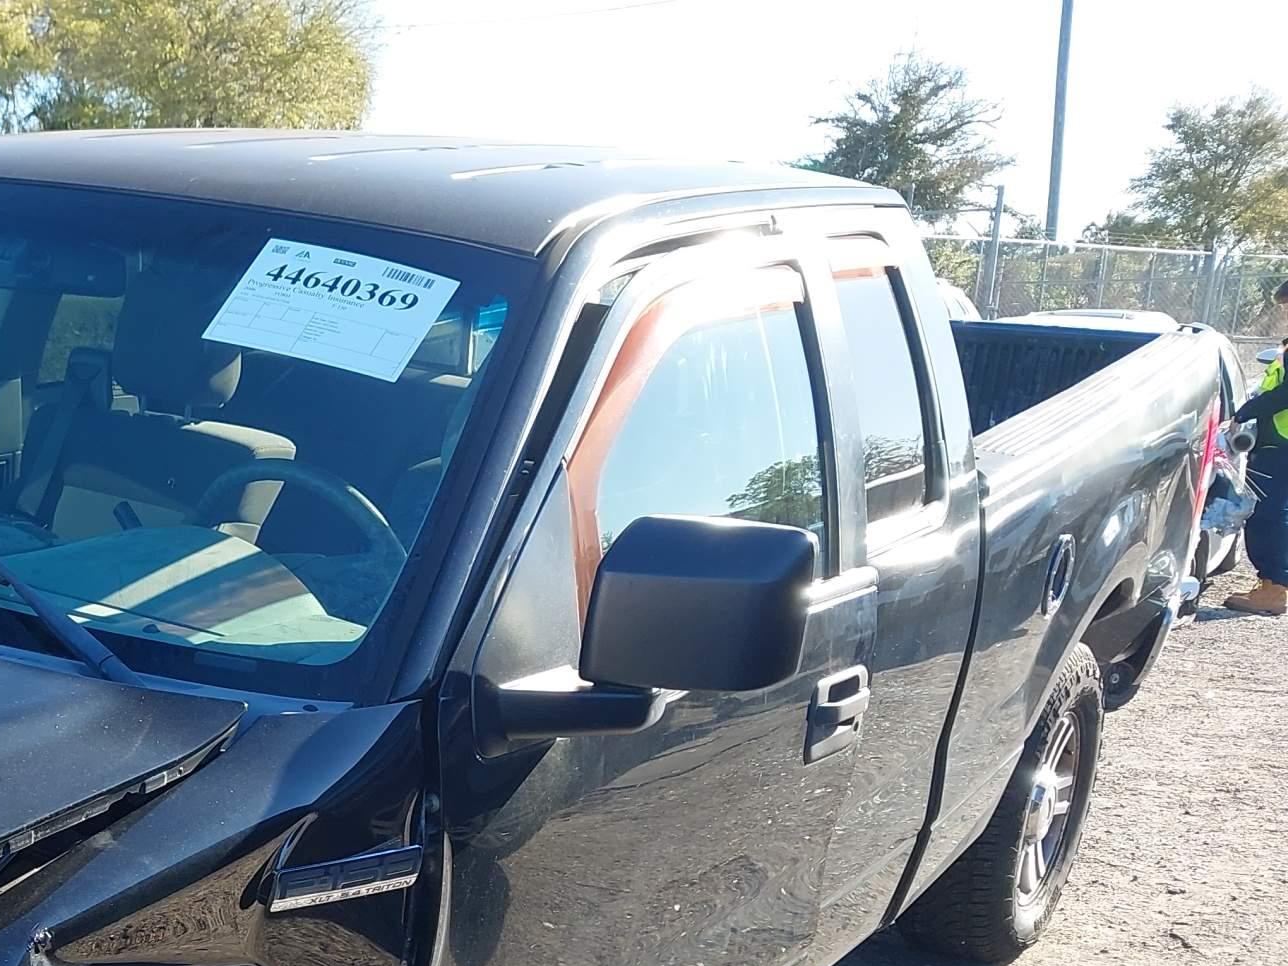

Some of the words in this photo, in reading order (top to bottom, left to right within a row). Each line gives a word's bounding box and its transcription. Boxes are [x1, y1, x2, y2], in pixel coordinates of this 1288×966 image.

[247, 278, 292, 292] Progressive
[265, 263, 420, 311] 44640369
[309, 895, 333, 905] XLT
[365, 880, 412, 895] TRITON
